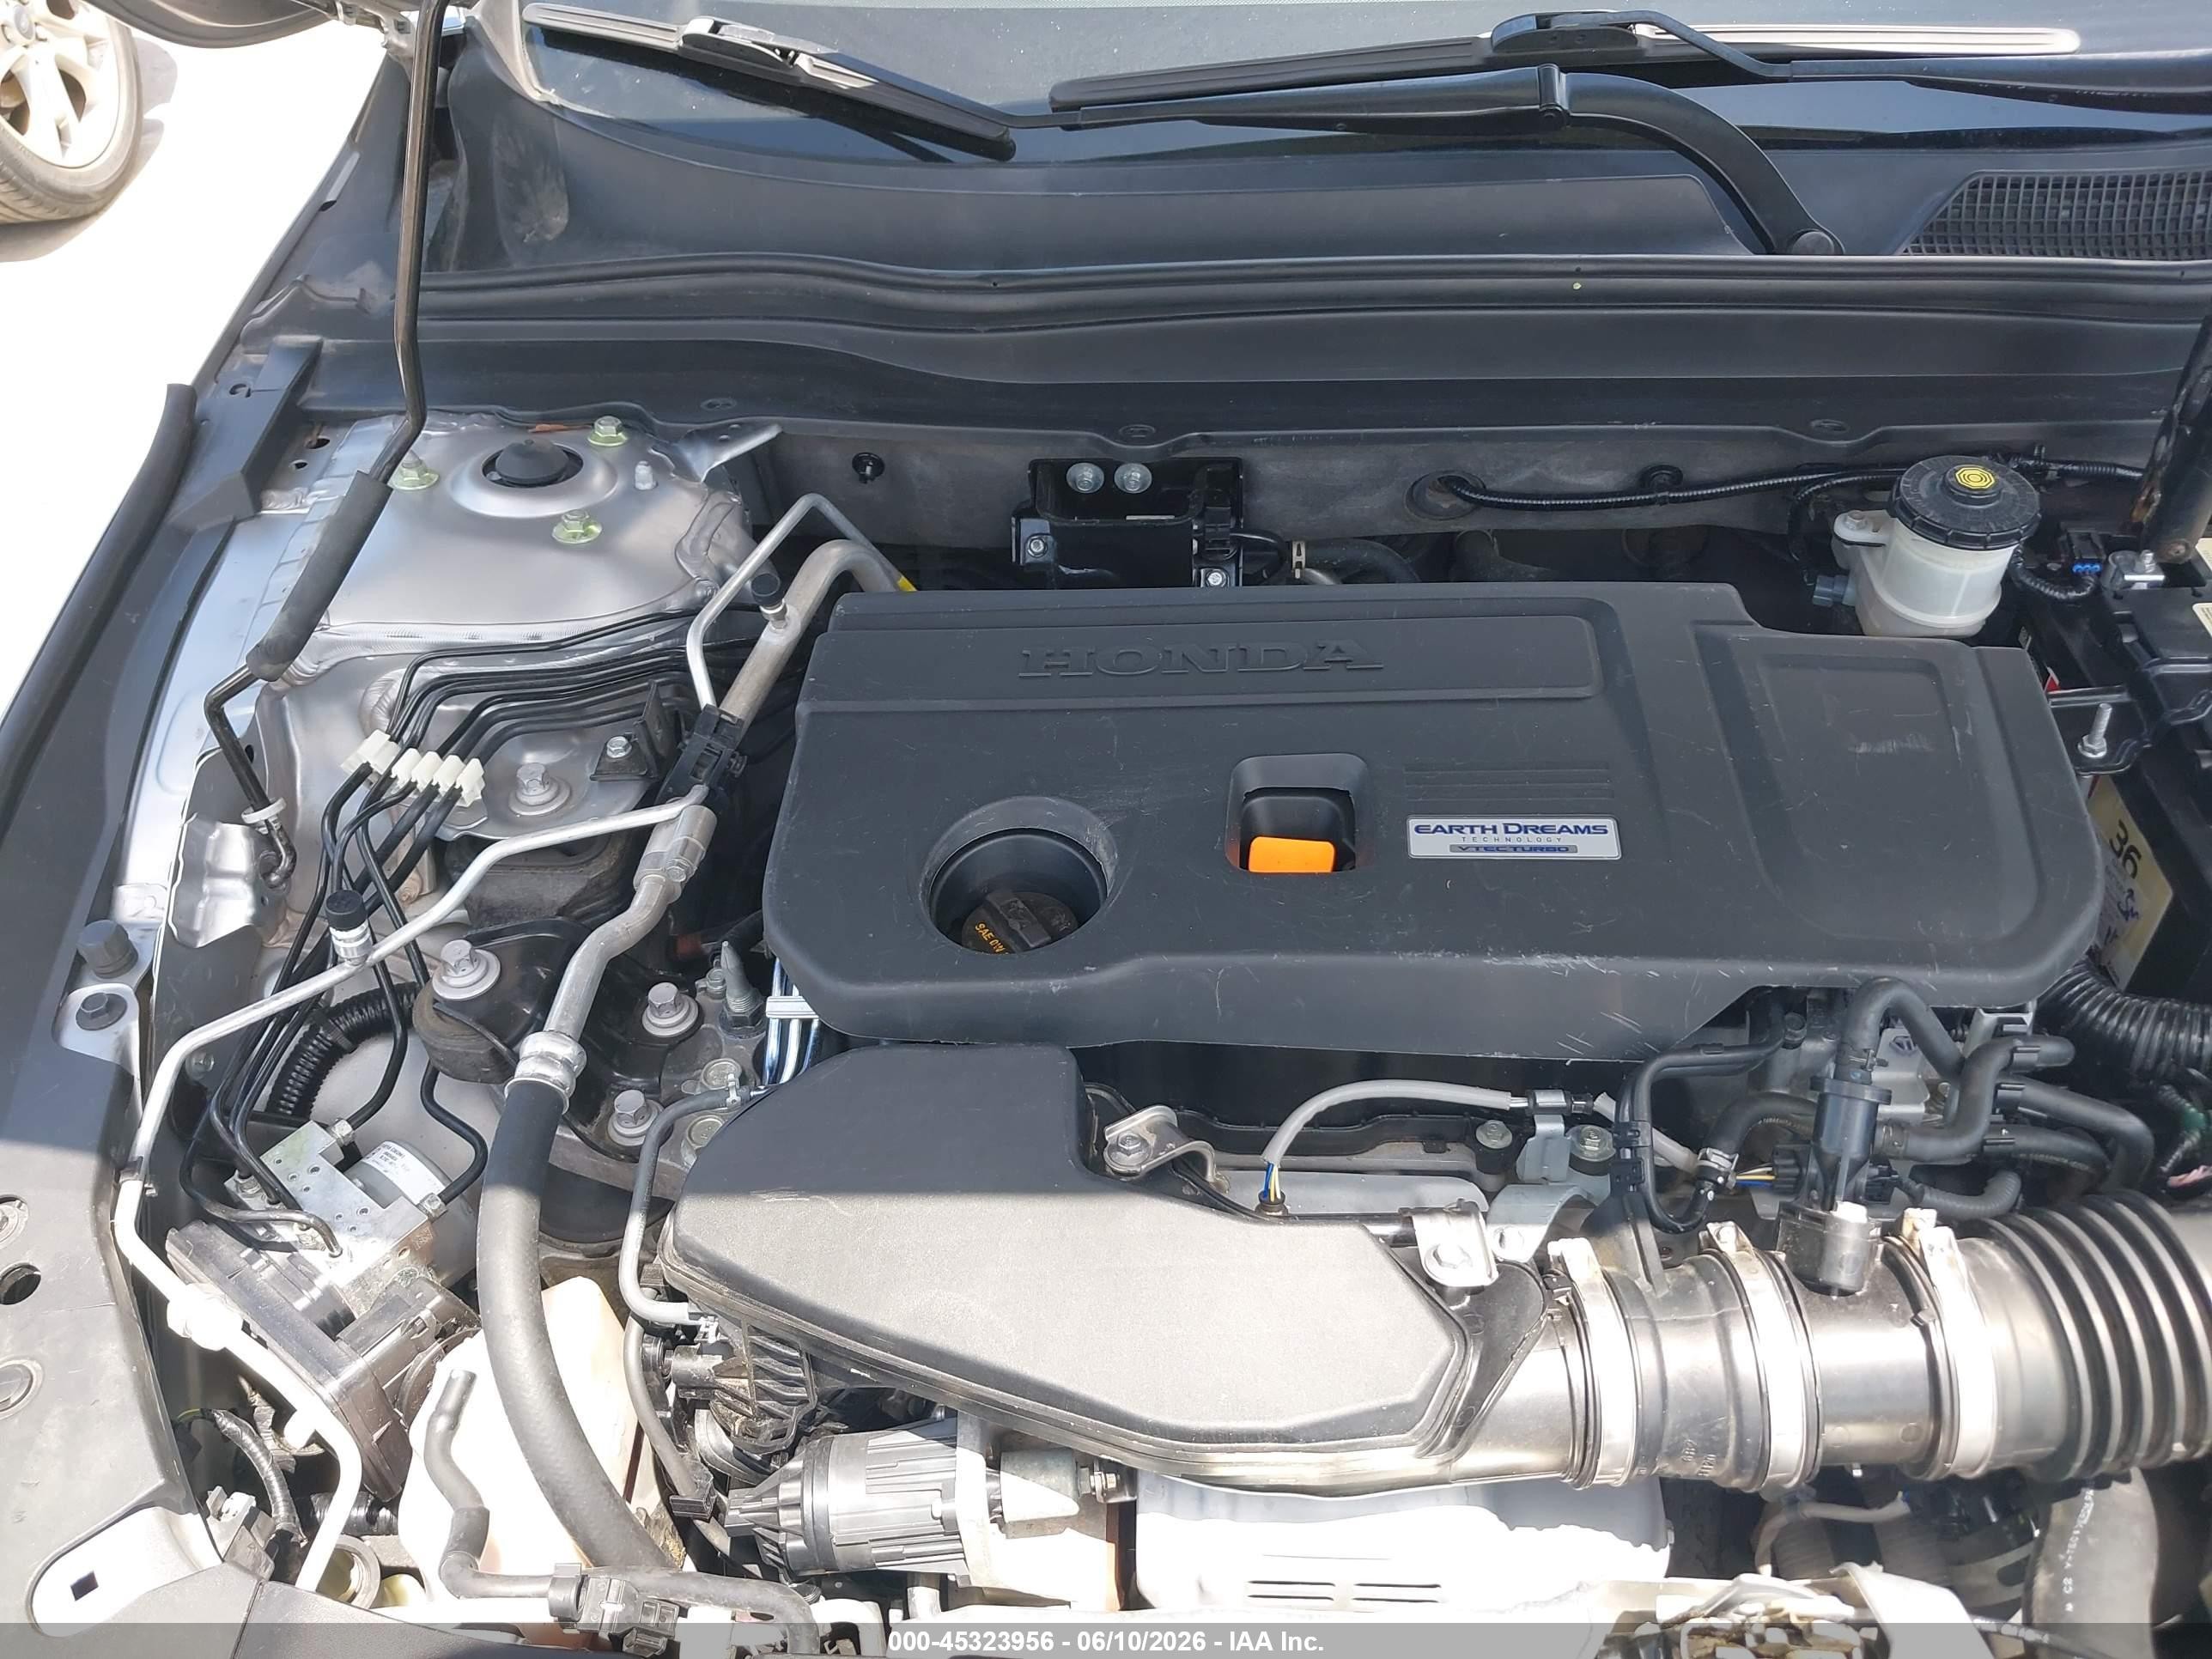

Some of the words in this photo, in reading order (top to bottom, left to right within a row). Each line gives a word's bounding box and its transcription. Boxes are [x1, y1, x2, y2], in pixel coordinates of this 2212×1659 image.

[1018, 639, 1383, 678] HONDA
[1413, 823, 1498, 835] EARTH
[1501, 822, 1609, 835] DREAMS
[975, 922, 994, 941] SAE
